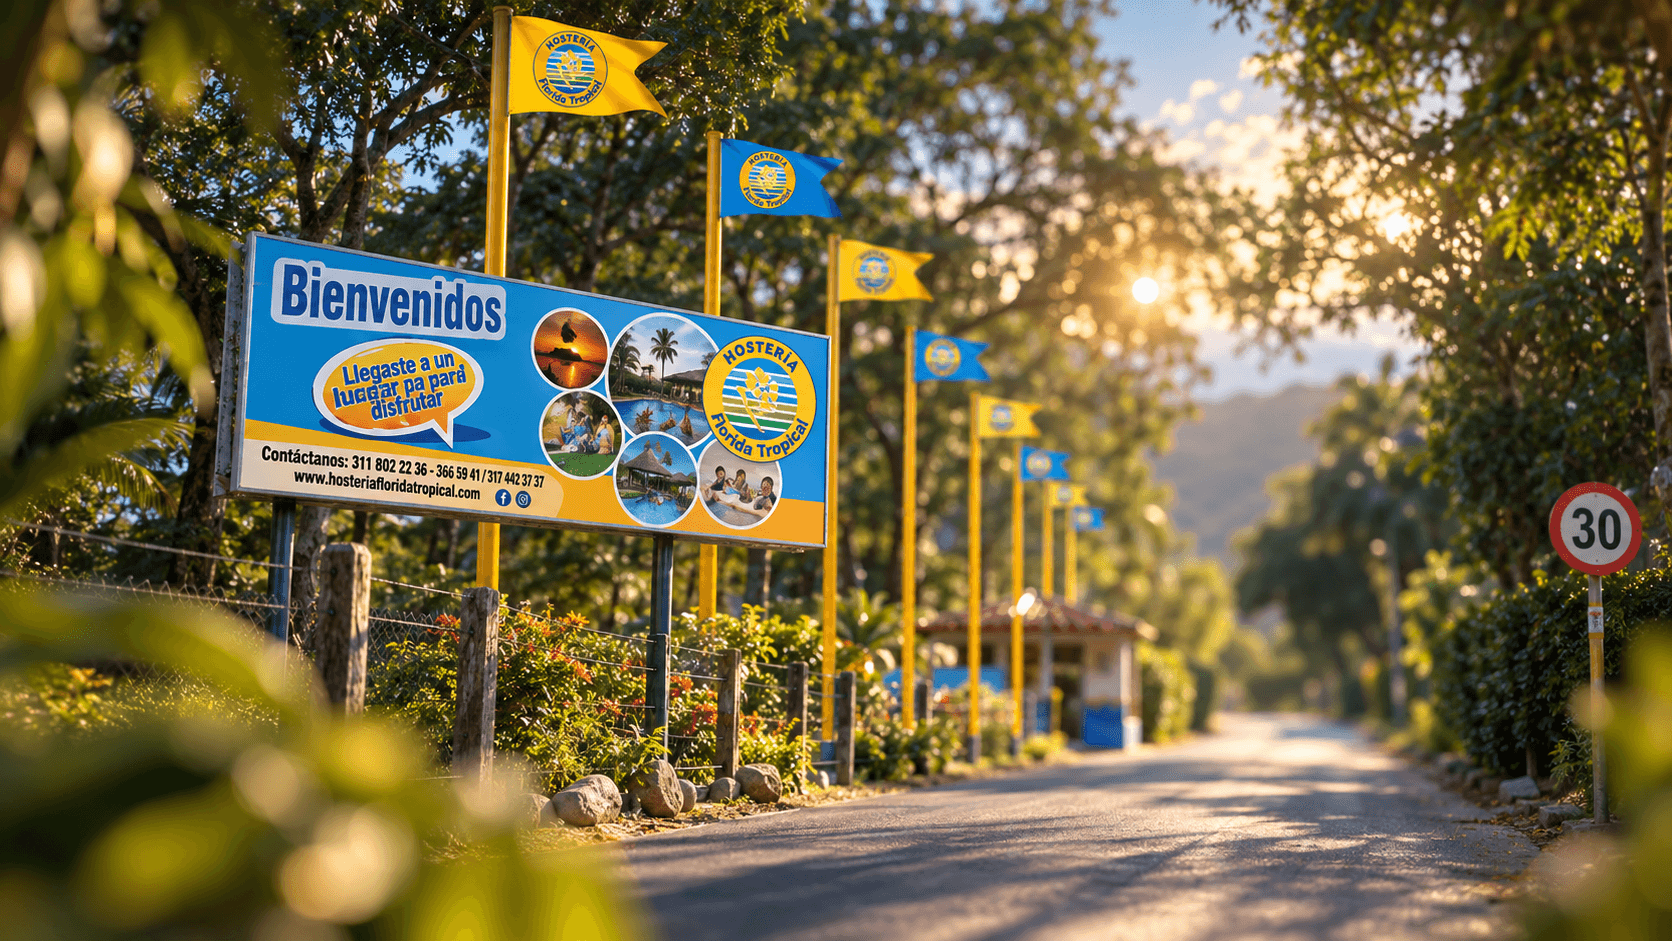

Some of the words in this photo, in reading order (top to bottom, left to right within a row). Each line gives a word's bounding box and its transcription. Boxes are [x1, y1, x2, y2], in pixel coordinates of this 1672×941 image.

[281, 263, 502, 334] Bienvenidos
[342, 357, 417, 386] Llegaste
[420, 356, 431, 372] a
[433, 353, 455, 369] un
[403, 377, 425, 398] pa
[370, 391, 444, 421] disfrutar
[711, 413, 753, 456] Florida
[756, 418, 809, 458] Tropical
[261, 445, 349, 468] Contáctanos:
[352, 455, 372, 471] 311
[375, 457, 397, 473] 802
[399, 460, 412, 475] 22
[414, 462, 428, 476] 36
[436, 464, 454, 479] 366
[456, 466, 468, 480] 59
[469, 468, 480, 482] 41
[522, 473, 533, 487] 37
[533, 475, 545, 488] 37
[294, 471, 481, 500] www.hosteriafloridatropical.com
[1572, 507, 1622, 550] 30
